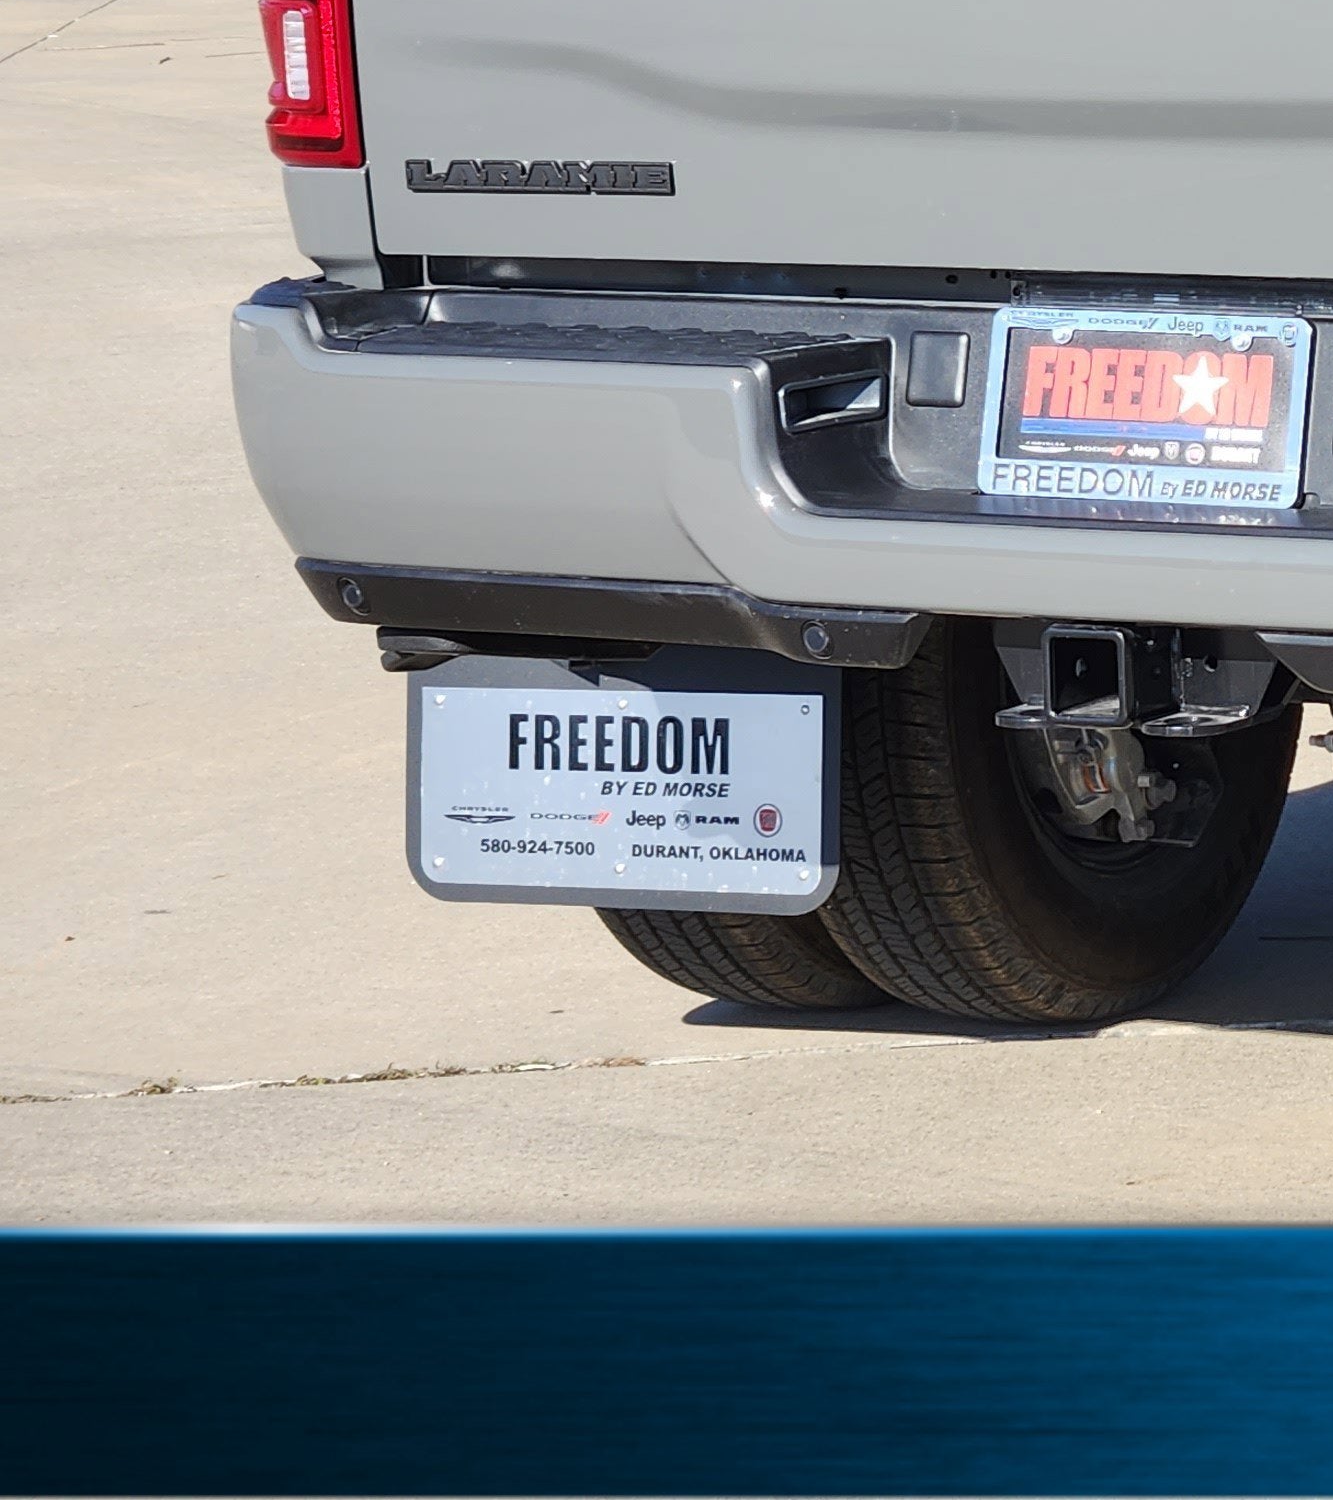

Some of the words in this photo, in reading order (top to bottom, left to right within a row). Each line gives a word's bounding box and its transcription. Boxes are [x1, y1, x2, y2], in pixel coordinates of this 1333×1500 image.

[405, 159, 676, 196] LARAMIE
[1167, 316, 1204, 335] Jeep
[1233, 324, 1268, 333] RAM
[1022, 345, 1274, 428] FREEDOM
[992, 463, 1154, 498] FREEDOM
[1181, 480, 1208, 498] ED
[1210, 481, 1282, 502] MORSE
[508, 713, 730, 775] FREEDOM
[600, 780, 628, 797] BY
[632, 781, 657, 797] ED
[662, 782, 731, 798] MORSE
[529, 812, 596, 822] DODGE
[625, 810, 667, 832] Jeep
[694, 815, 740, 826] RAM
[480, 838, 595, 857] 580-924-7500
[631, 845, 704, 863] DURANT,
[709, 846, 807, 863] OKLAHOMA
